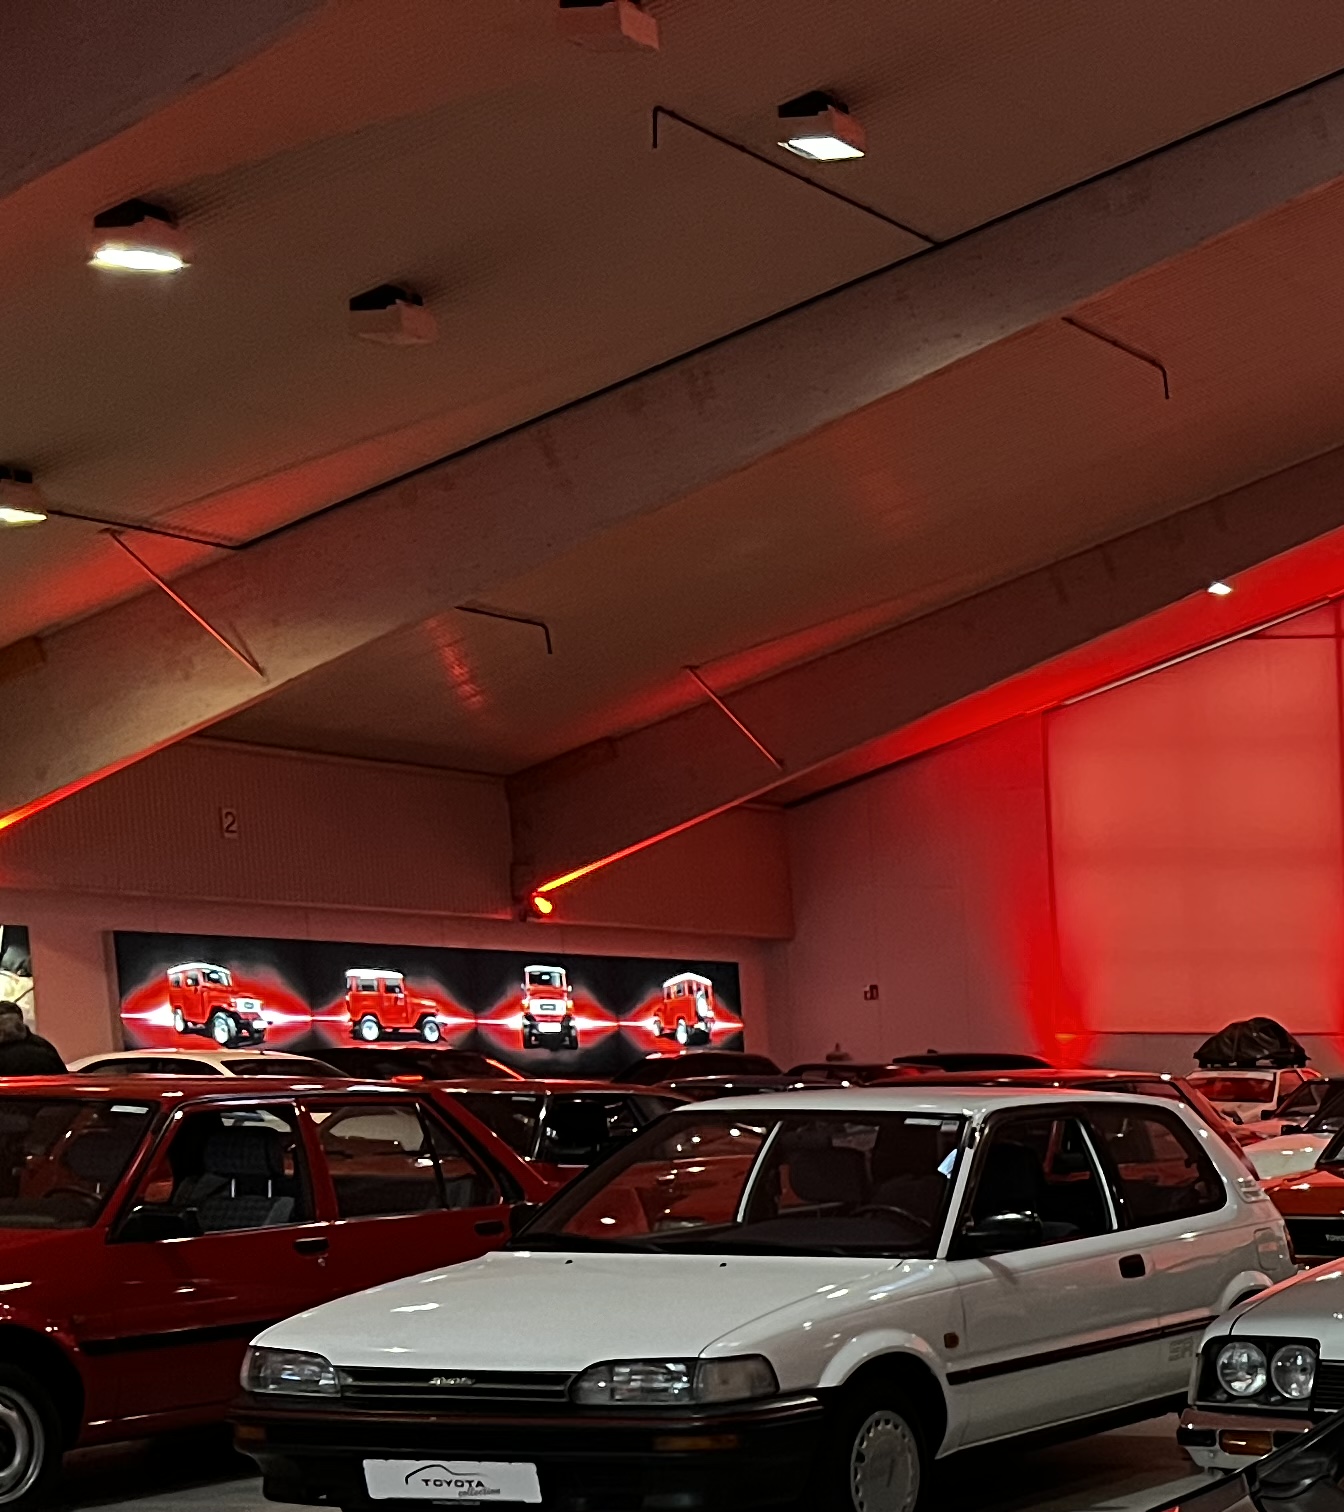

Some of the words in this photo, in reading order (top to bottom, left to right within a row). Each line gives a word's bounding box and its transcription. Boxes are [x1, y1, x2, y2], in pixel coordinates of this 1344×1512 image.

[224, 811, 238, 833] 2
[421, 1478, 486, 1488] TOYOTA
[458, 1486, 501, 1497] collection
